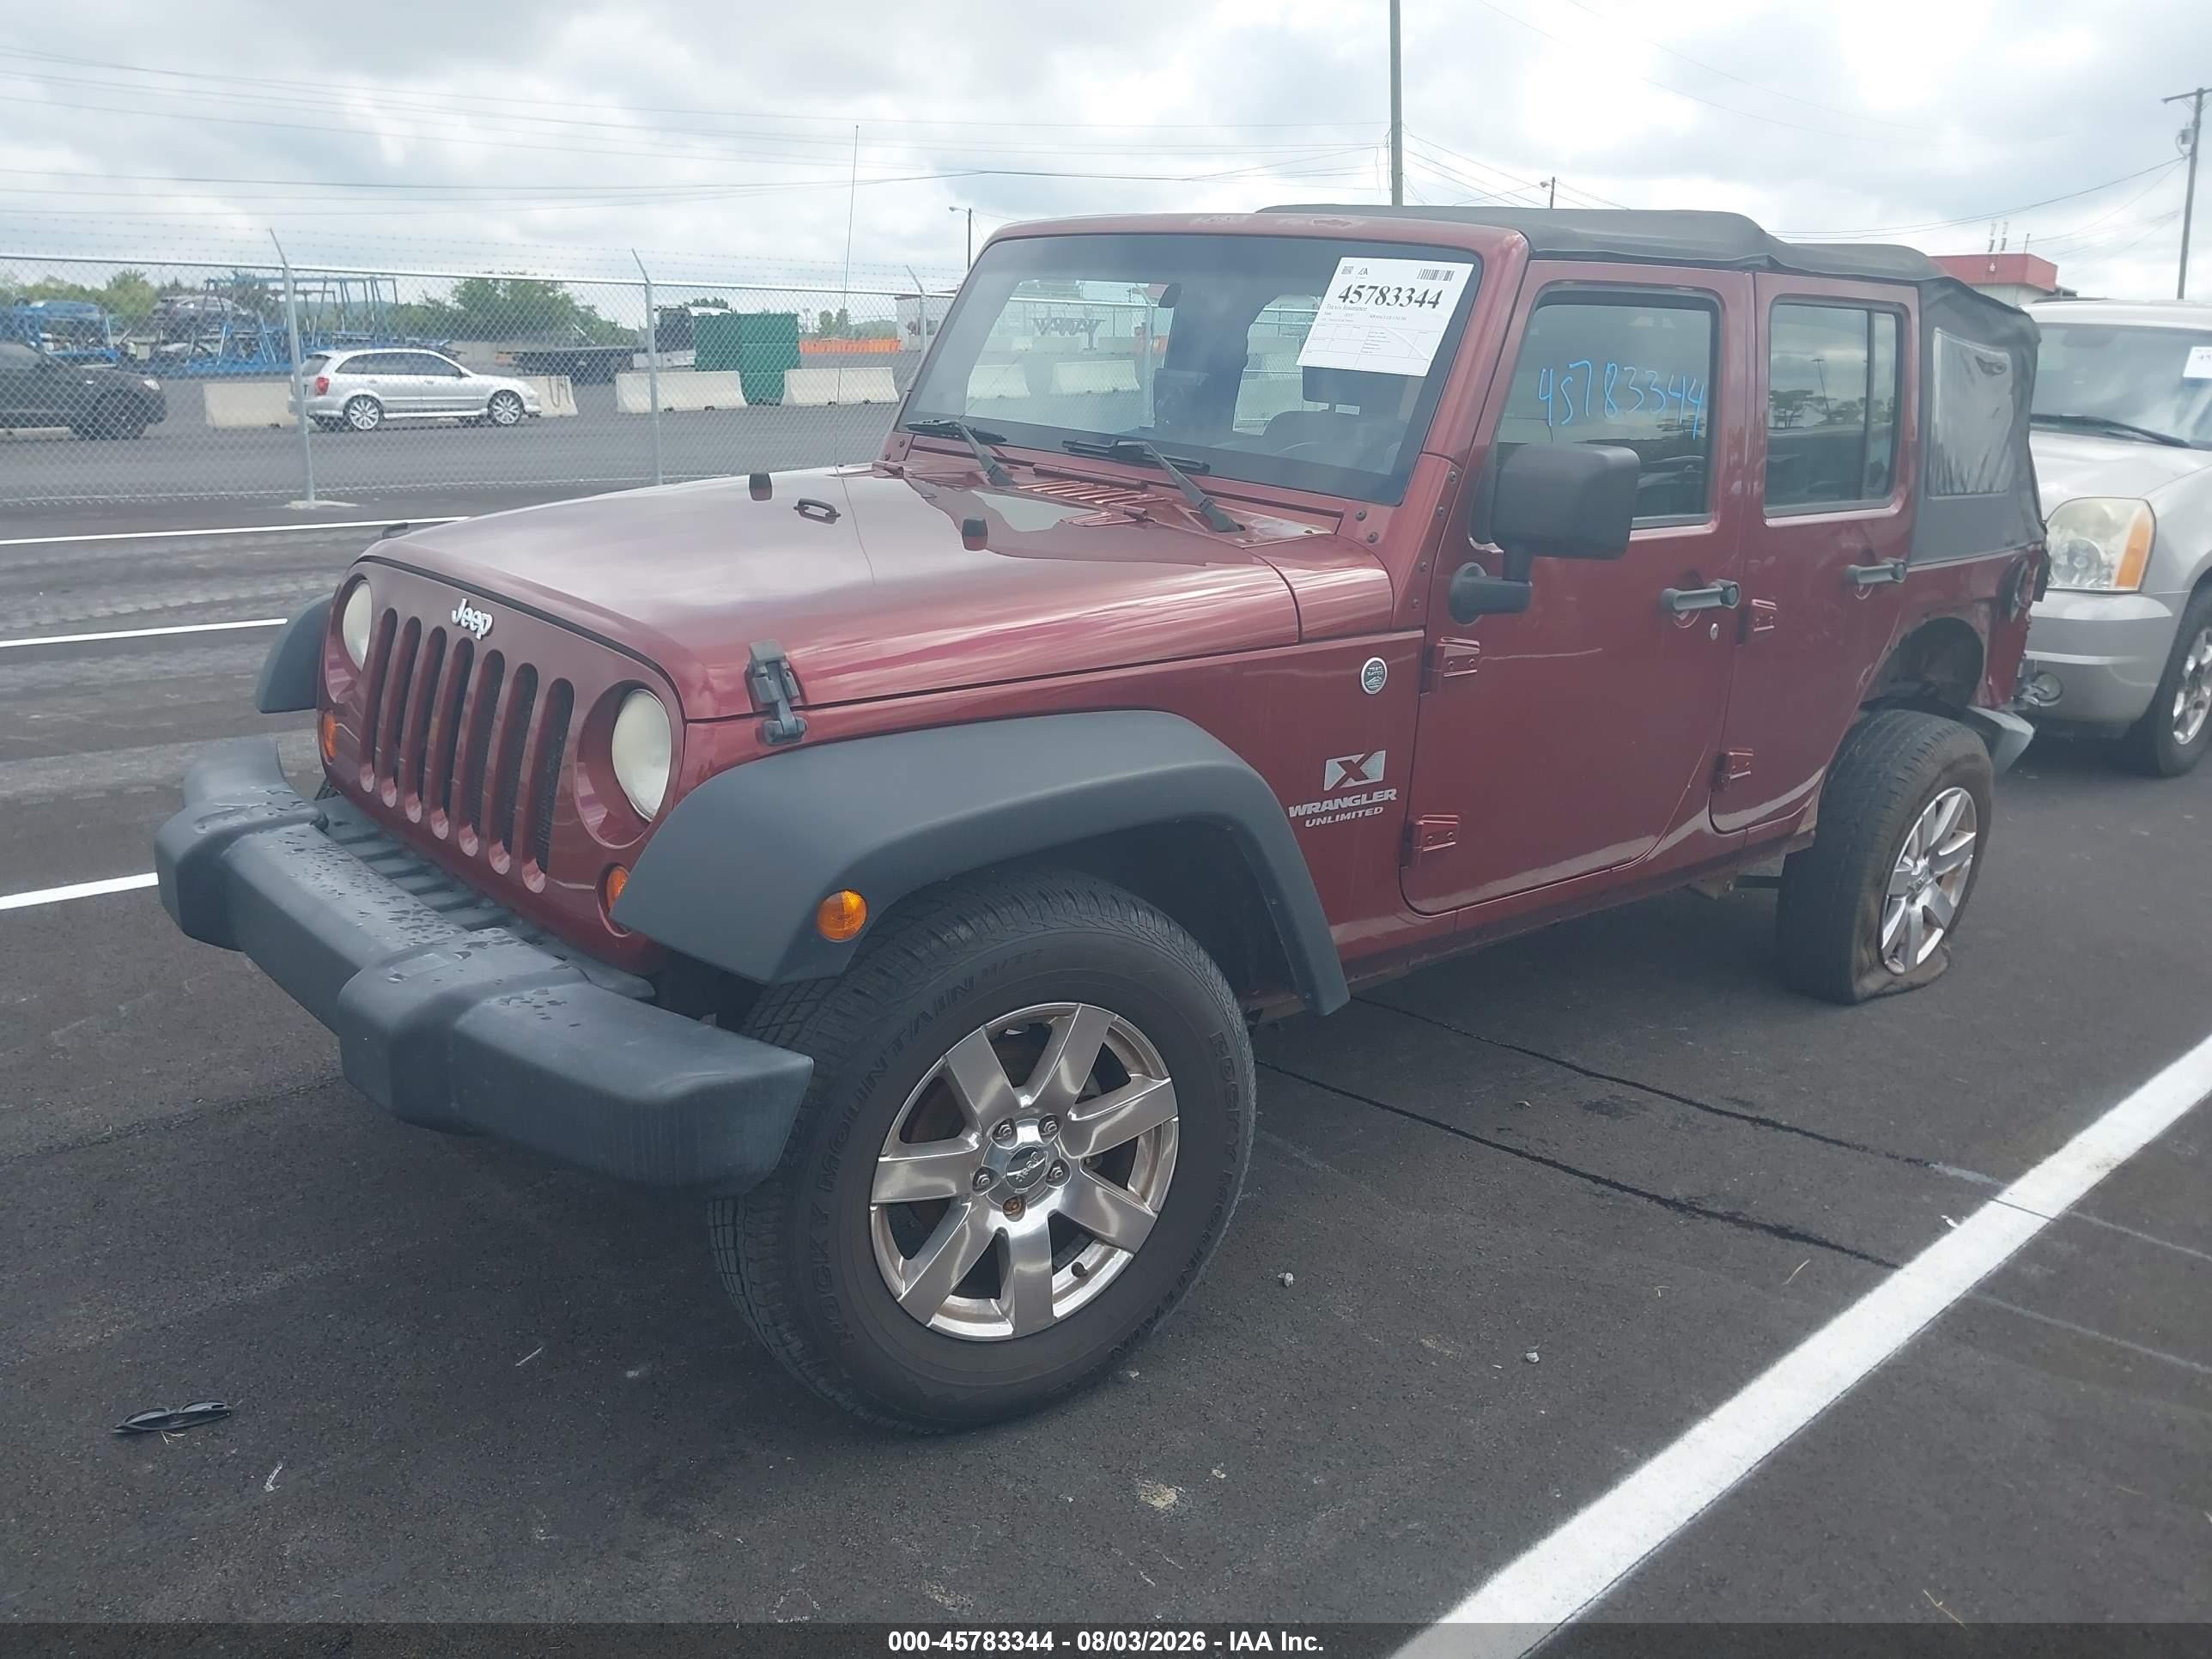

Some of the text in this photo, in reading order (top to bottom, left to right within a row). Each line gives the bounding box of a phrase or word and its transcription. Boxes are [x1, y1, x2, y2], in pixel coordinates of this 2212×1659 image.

[1338, 284, 1443, 309] 45783344
[1538, 360, 1705, 440] 45783344
[452, 598, 493, 640] Jeep
[1288, 788, 1397, 817] WRANGLER
[1304, 806, 1384, 828] UNLIMITED
